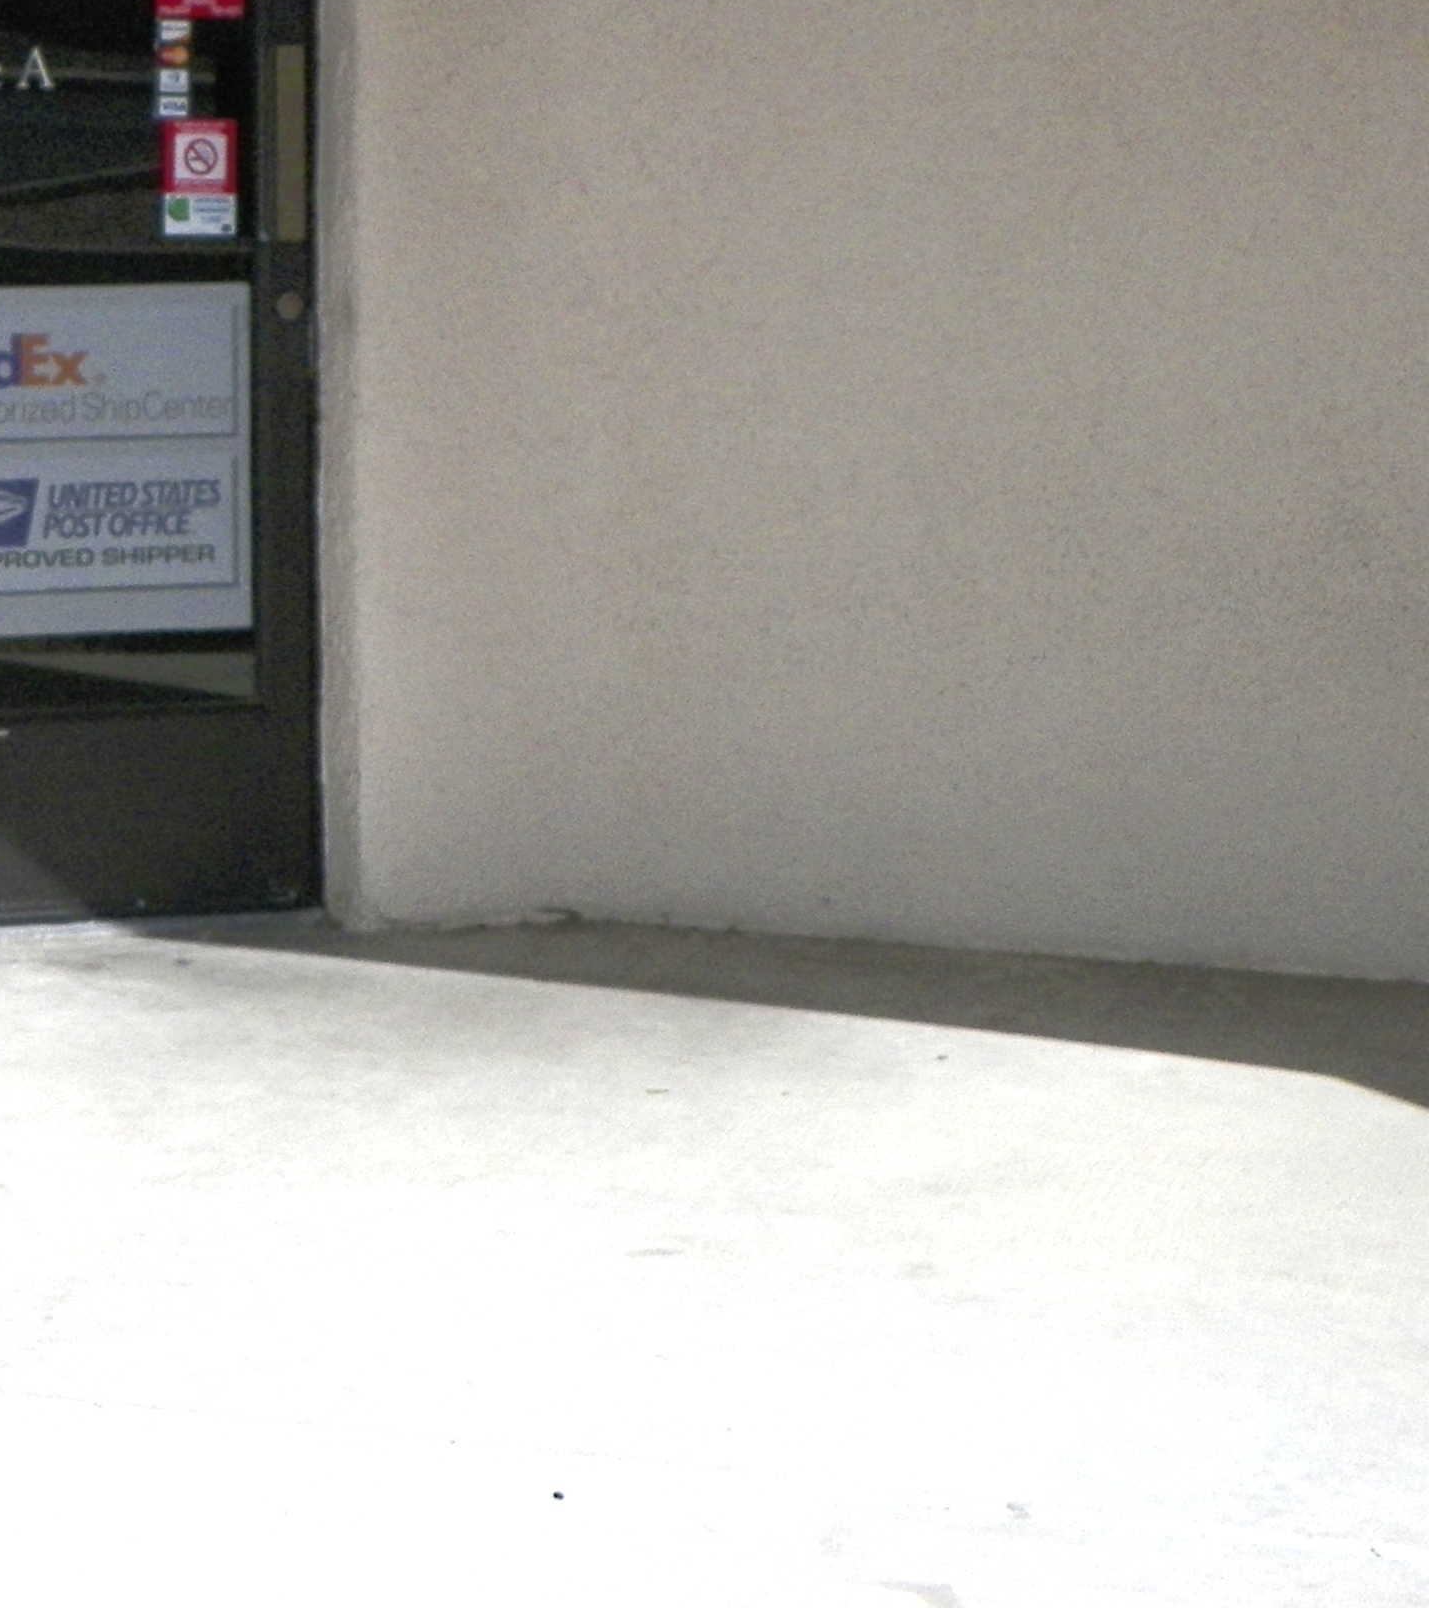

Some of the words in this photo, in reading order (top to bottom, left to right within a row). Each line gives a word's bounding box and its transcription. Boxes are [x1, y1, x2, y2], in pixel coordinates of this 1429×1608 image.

[17, 46, 56, 90] A
[48, 481, 138, 508] UNITED
[143, 479, 221, 506] STATES
[42, 512, 105, 539] POST
[107, 510, 191, 537] OFFICE
[100, 545, 215, 567] SHIPPER
